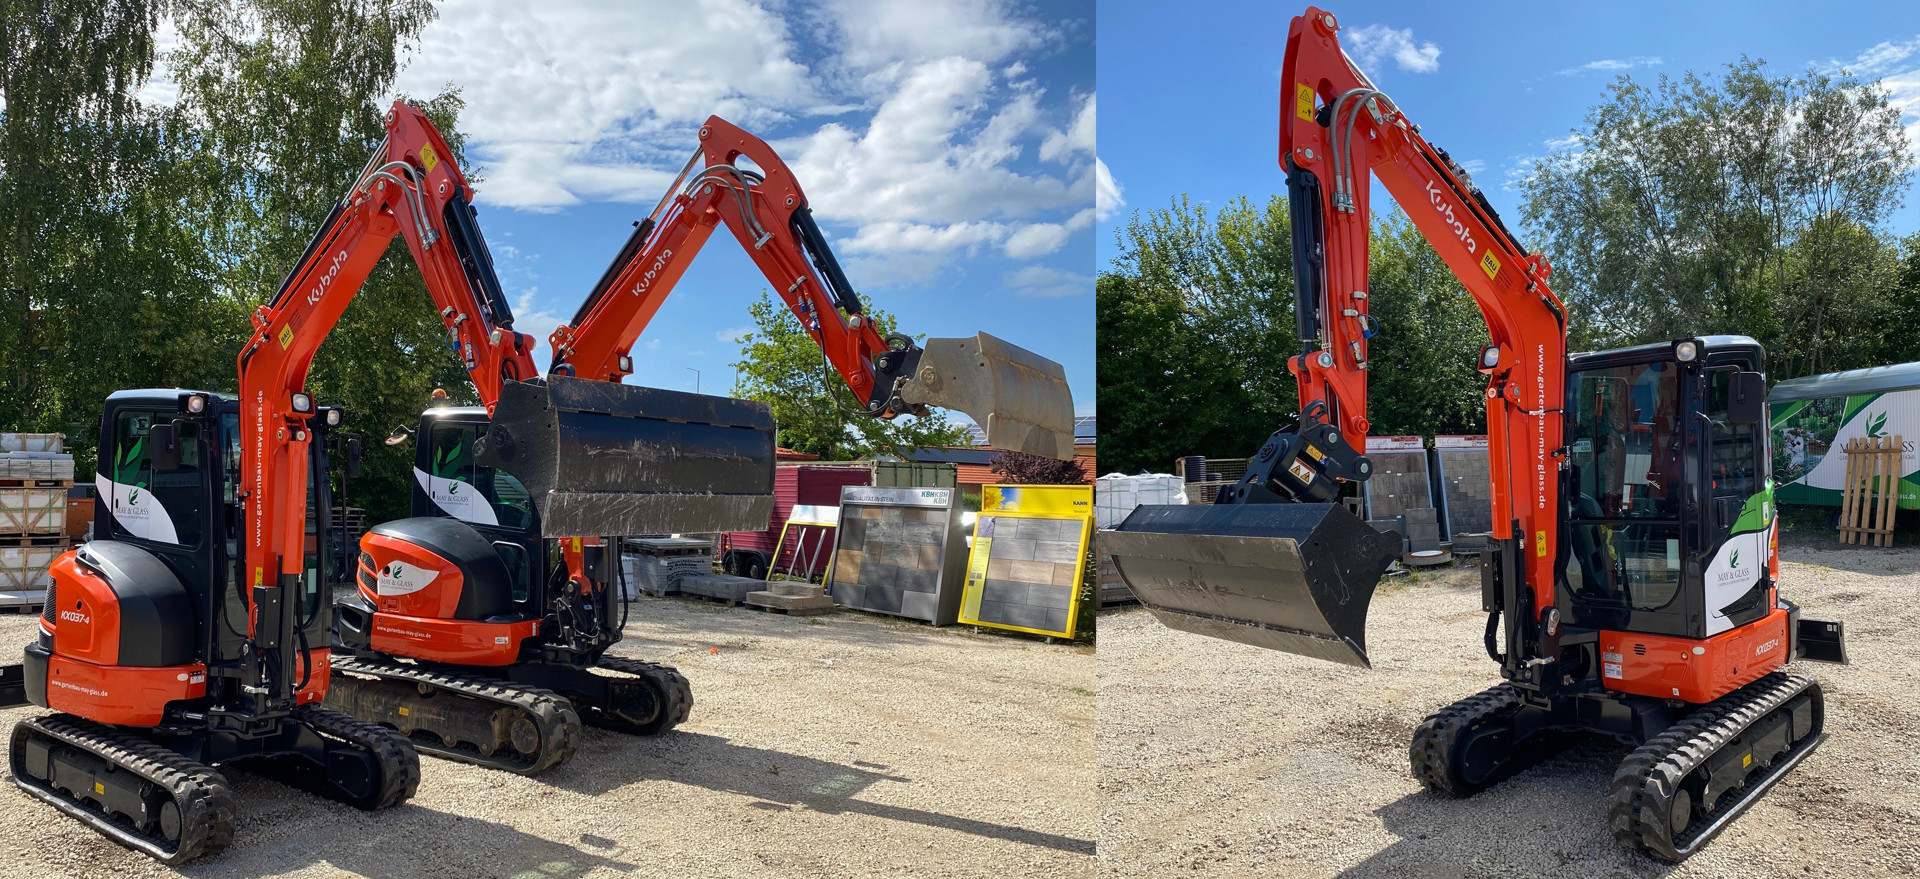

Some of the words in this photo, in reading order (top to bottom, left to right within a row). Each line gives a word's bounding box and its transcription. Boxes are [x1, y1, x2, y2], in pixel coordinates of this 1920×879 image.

[1426, 180, 1476, 254] Kubota
[1484, 255, 1497, 271] BAU
[307, 250, 348, 306] Kubota
[632, 249, 672, 296] Kubota
[281, 329, 290, 344] BAU
[1537, 344, 1546, 509] www.gartenbau-may-glass.de
[132, 507, 149, 516] GLASS
[1718, 571, 1729, 582] MAY
[1735, 568, 1750, 579] GLASS
[60, 610, 90, 624] KX037-4
[376, 626, 432, 639] www.gartenbau-may-glass.de
[1755, 638, 1779, 656] KX037-4
[51, 679, 108, 697] www.gartenbau-may-glass.de
